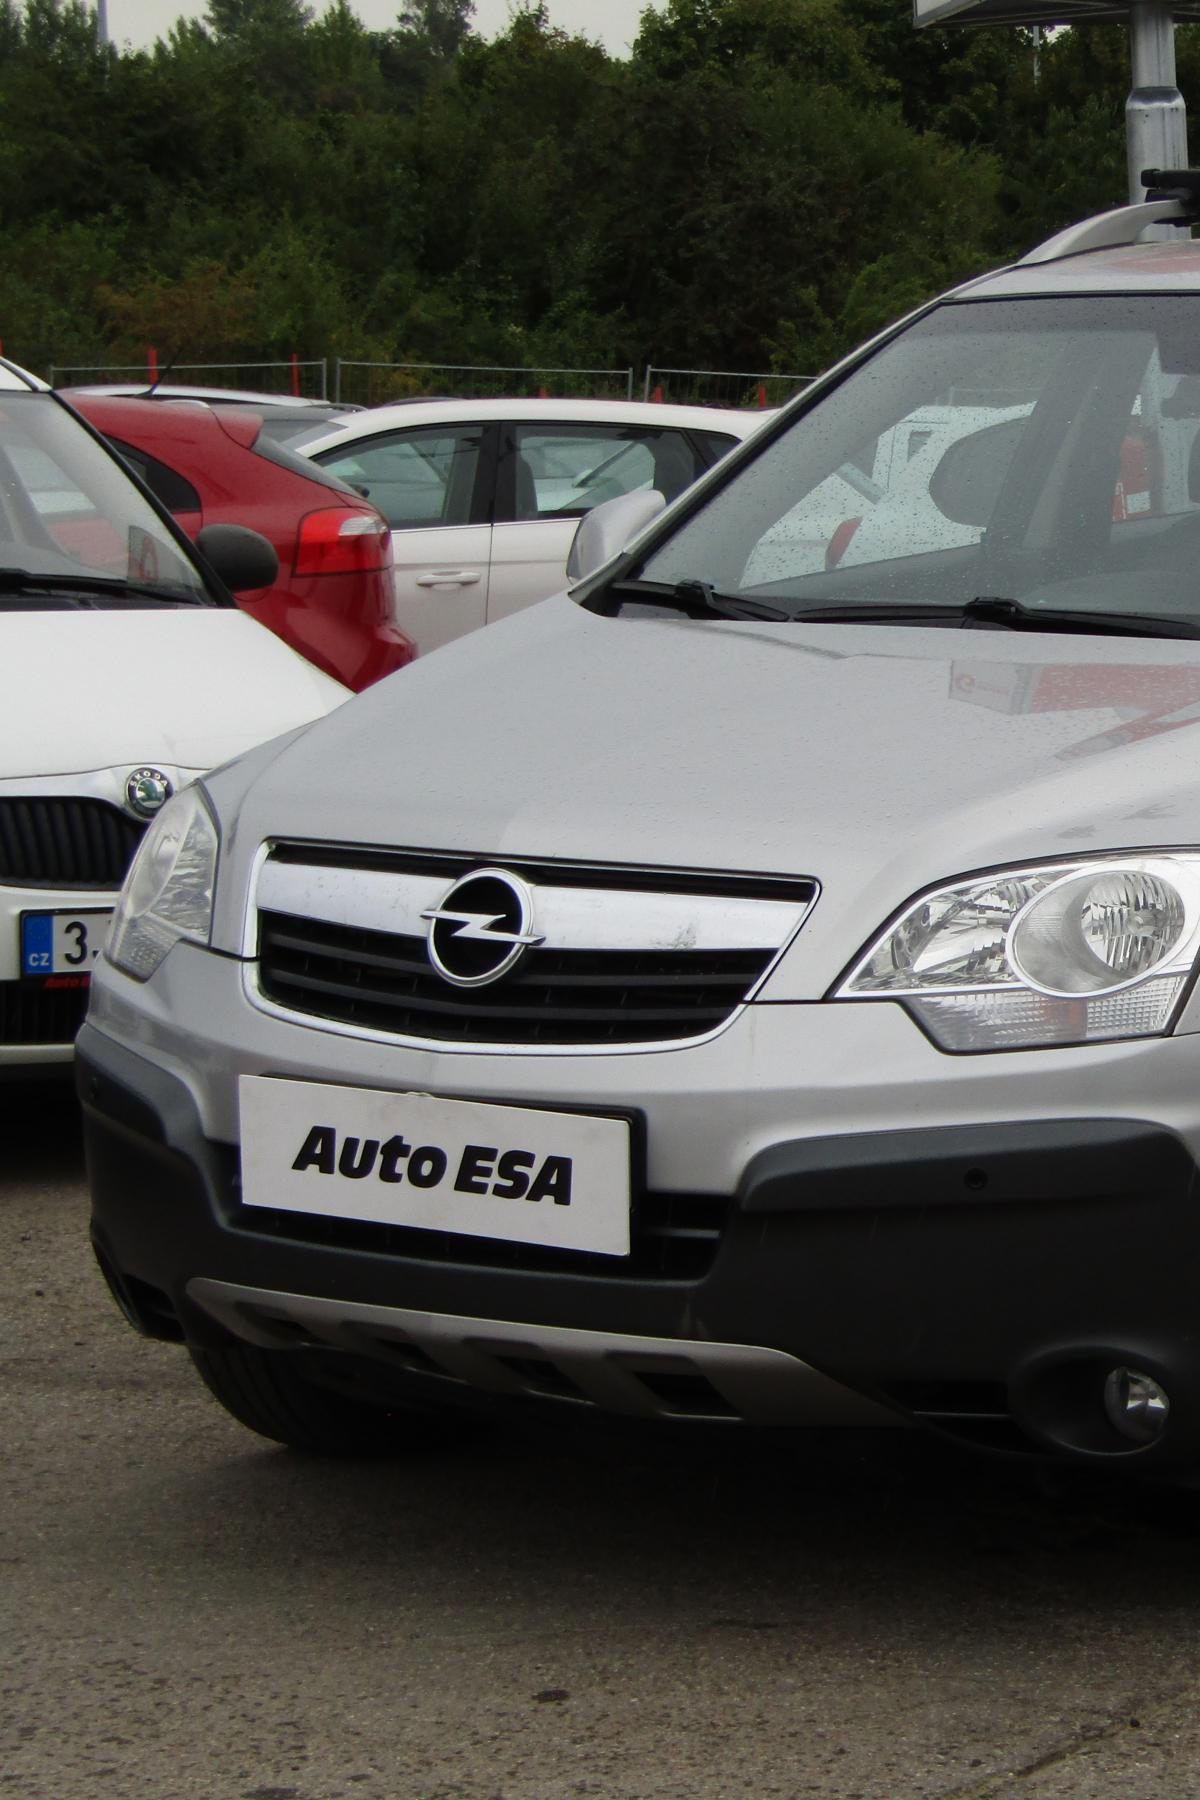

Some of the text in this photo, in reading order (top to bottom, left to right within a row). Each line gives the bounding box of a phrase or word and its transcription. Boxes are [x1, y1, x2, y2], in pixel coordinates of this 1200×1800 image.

[28, 952, 50, 967] CZ
[64, 921, 100, 965] 3
[291, 1125, 573, 1206] Auto ESA
